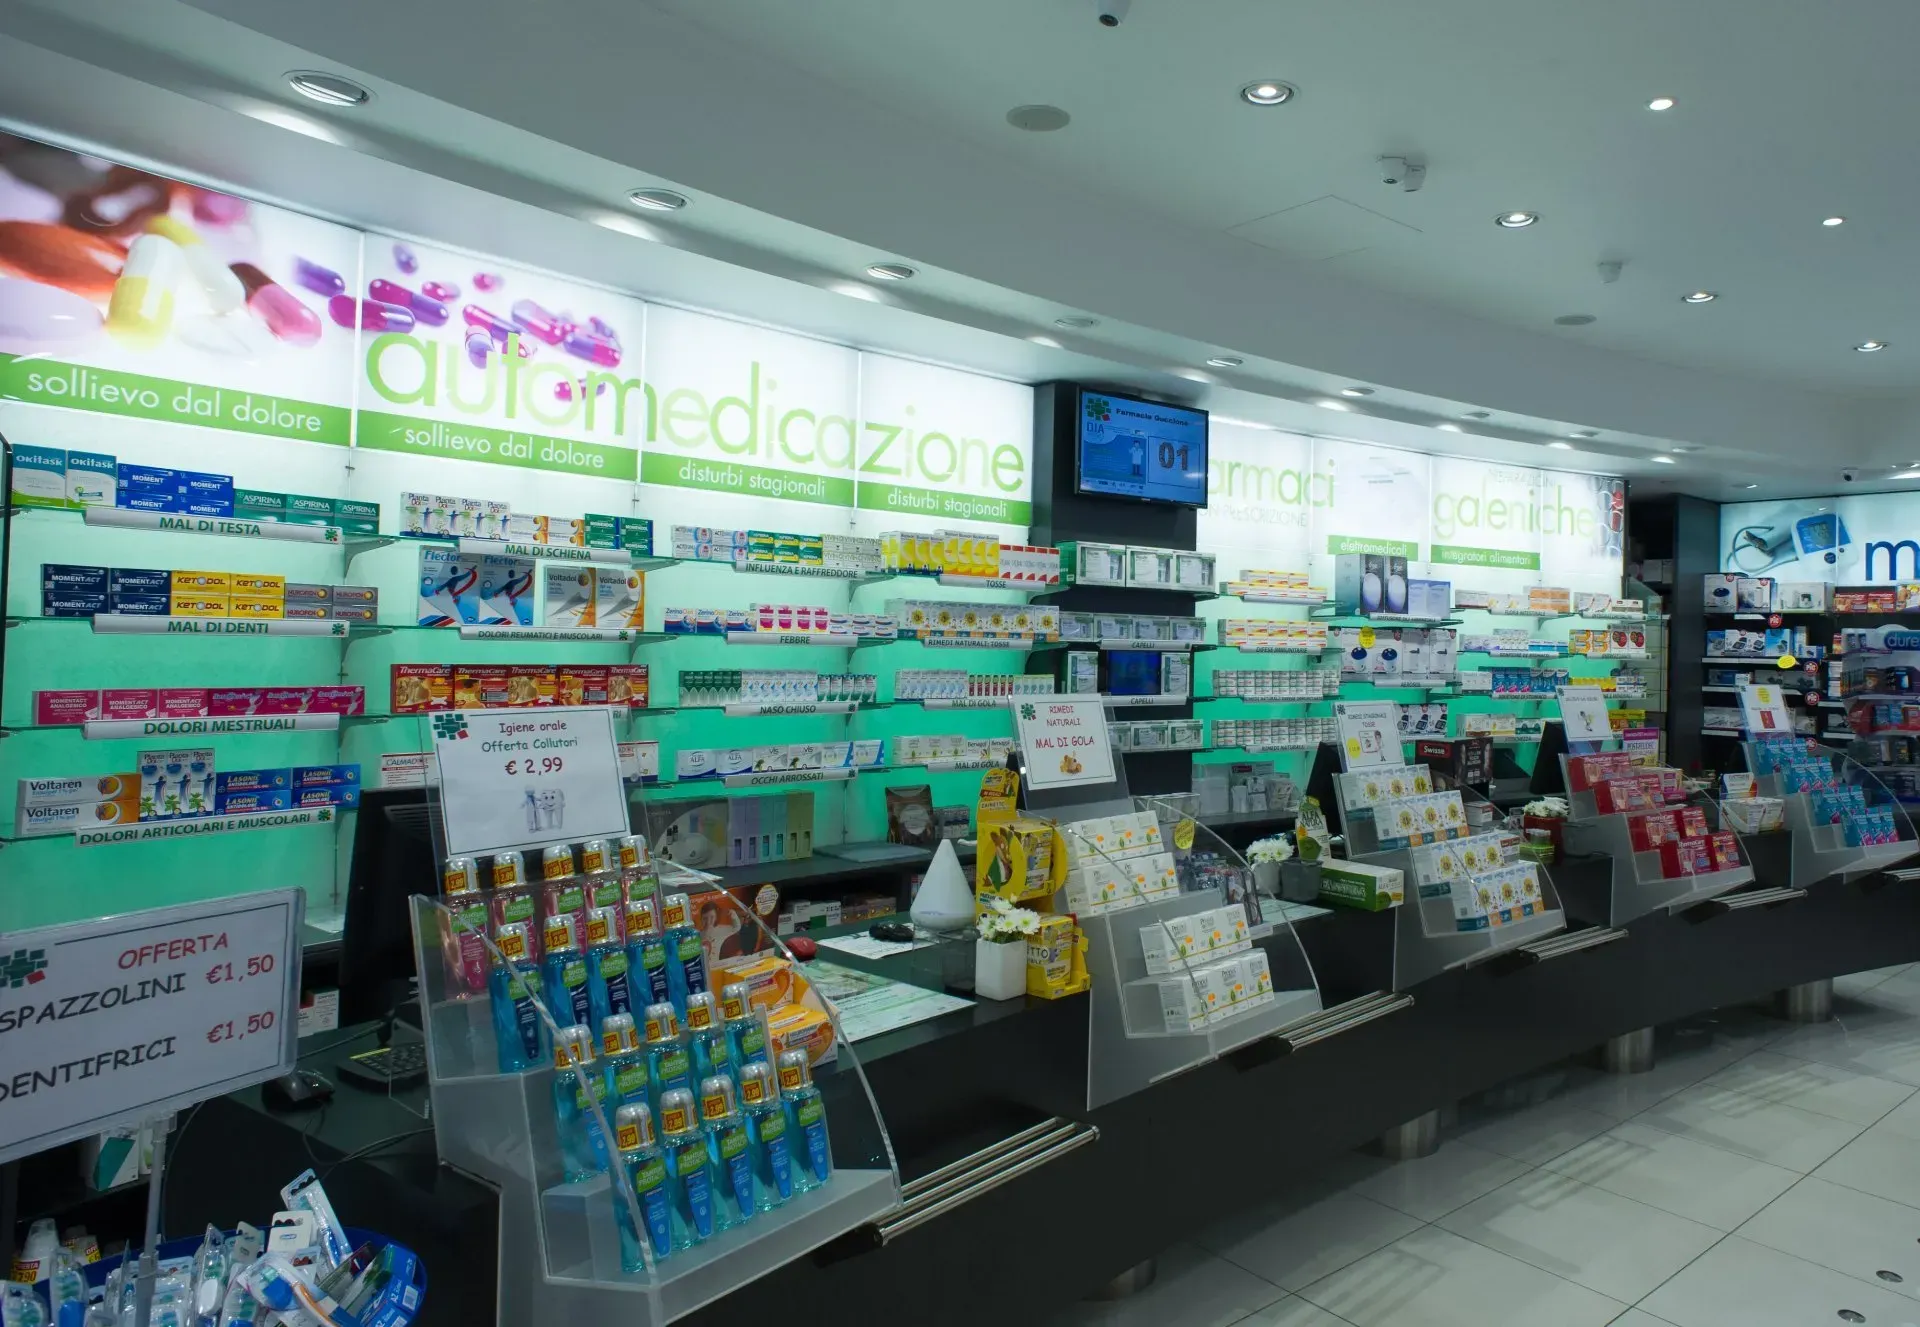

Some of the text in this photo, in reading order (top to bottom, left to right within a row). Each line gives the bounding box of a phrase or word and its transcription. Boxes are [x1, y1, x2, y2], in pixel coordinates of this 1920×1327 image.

[27, 369, 321, 432] sollievo dal dolore
[366, 332, 1023, 492] automedicazione
[1116, 408, 1152, 420] Farmacia
[1086, 422, 1104, 434] DIA
[405, 427, 604, 468] sollievo dal dolore
[1158, 441, 1189, 471] 01
[132, 474, 164, 484] MOMENT
[679, 460, 826, 499] disturbi stagionali
[190, 480, 221, 490] MOMENT
[131, 499, 163, 508] MOMENT
[243, 495, 281, 506] ASPIRINA
[293, 500, 330, 510] ASPIRINA
[888, 488, 1006, 519] disturbi stagionali
[190, 505, 220, 514] MOMENT
[343, 504, 376, 514] ASPIRINA
[1433, 475, 1594, 540] galeniche
[160, 517, 261, 536] MAL DI TESTA
[424, 550, 460, 561] Flector
[505, 544, 591, 560] MAL DI SCHIENA
[484, 555, 517, 564] Flector
[746, 563, 858, 578] INFLUENZA E RAFFREDDORE
[51, 574, 101, 583] MOMENTACT
[118, 577, 164, 586] MOMENTACT
[549, 573, 576, 582] Voltadol
[599, 576, 626, 585] Voltadol
[986, 579, 1007, 588] TOSSE
[117, 603, 164, 611] MOMENTACT
[167, 621, 268, 633] MAL DI DENTI
[478, 630, 509, 638] DOLORI
[512, 632, 552, 640] REUMATICI
[560, 632, 602, 641] MUSCOLARI
[780, 635, 811, 644] FEBBRE
[1132, 641, 1155, 649] CAPELLI
[400, 666, 450, 674] ThermaCare
[511, 666, 556, 674] ThermaCare
[610, 666, 647, 674] ThermaCare
[760, 705, 816, 714] NASO CHIUSO
[144, 719, 296, 734] DOLORI MESTRUALI
[499, 720, 567, 736] Igiene orale
[1047, 718, 1080, 727] NATURALI
[482, 737, 578, 752] Offerta Collutori
[1036, 736, 1095, 749] MAL DI GOLA
[505, 757, 563, 776] € 2,99
[751, 772, 824, 785] OCCHI ARROSSATI
[30, 780, 82, 791] Voltaren
[26, 807, 80, 818] Voltaren
[79, 813, 311, 845] DOLORI ARTICOLARI E MUSCOLARI
[118, 932, 229, 970] OFFERTA
[0, 954, 274, 1033] SPAZZOLINI €1,50
[206, 1011, 275, 1043] €1,50
